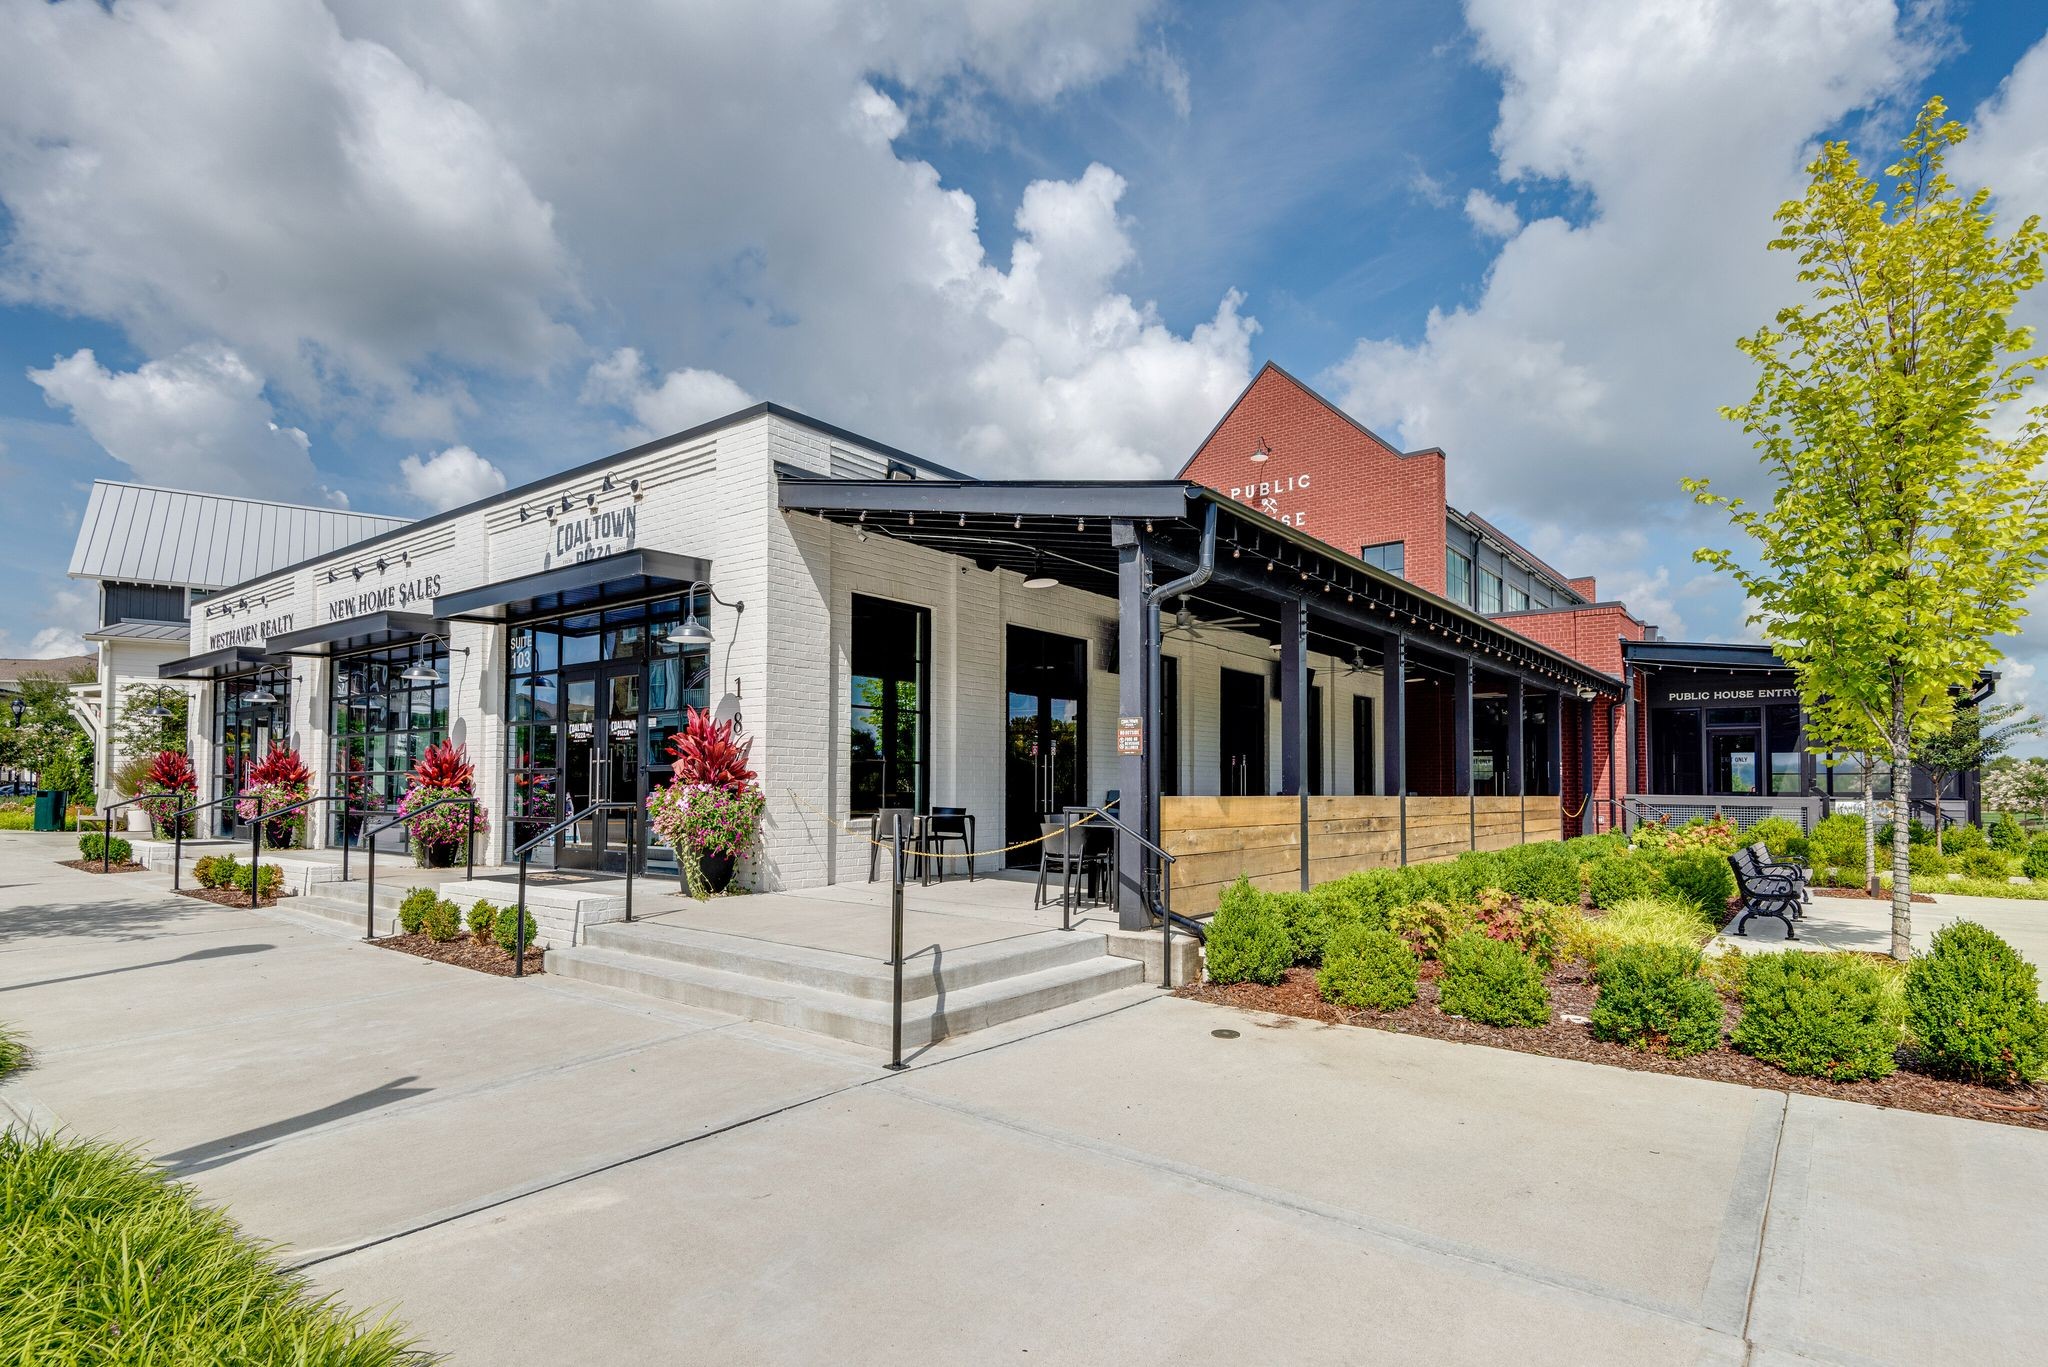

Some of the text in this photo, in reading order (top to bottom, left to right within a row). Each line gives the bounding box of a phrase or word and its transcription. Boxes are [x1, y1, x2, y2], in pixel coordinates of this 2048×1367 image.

[1230, 474, 1311, 500] PUBLIC
[557, 505, 637, 557] COALTOWN
[329, 574, 442, 621] NEW HOME SALES
[209, 613, 295, 650] WESTHAVEN REALTY
[510, 635, 533, 650] SUITE
[511, 650, 532, 669] 103
[1669, 688, 1798, 701] PUBLIC HOUSE ENTRY
